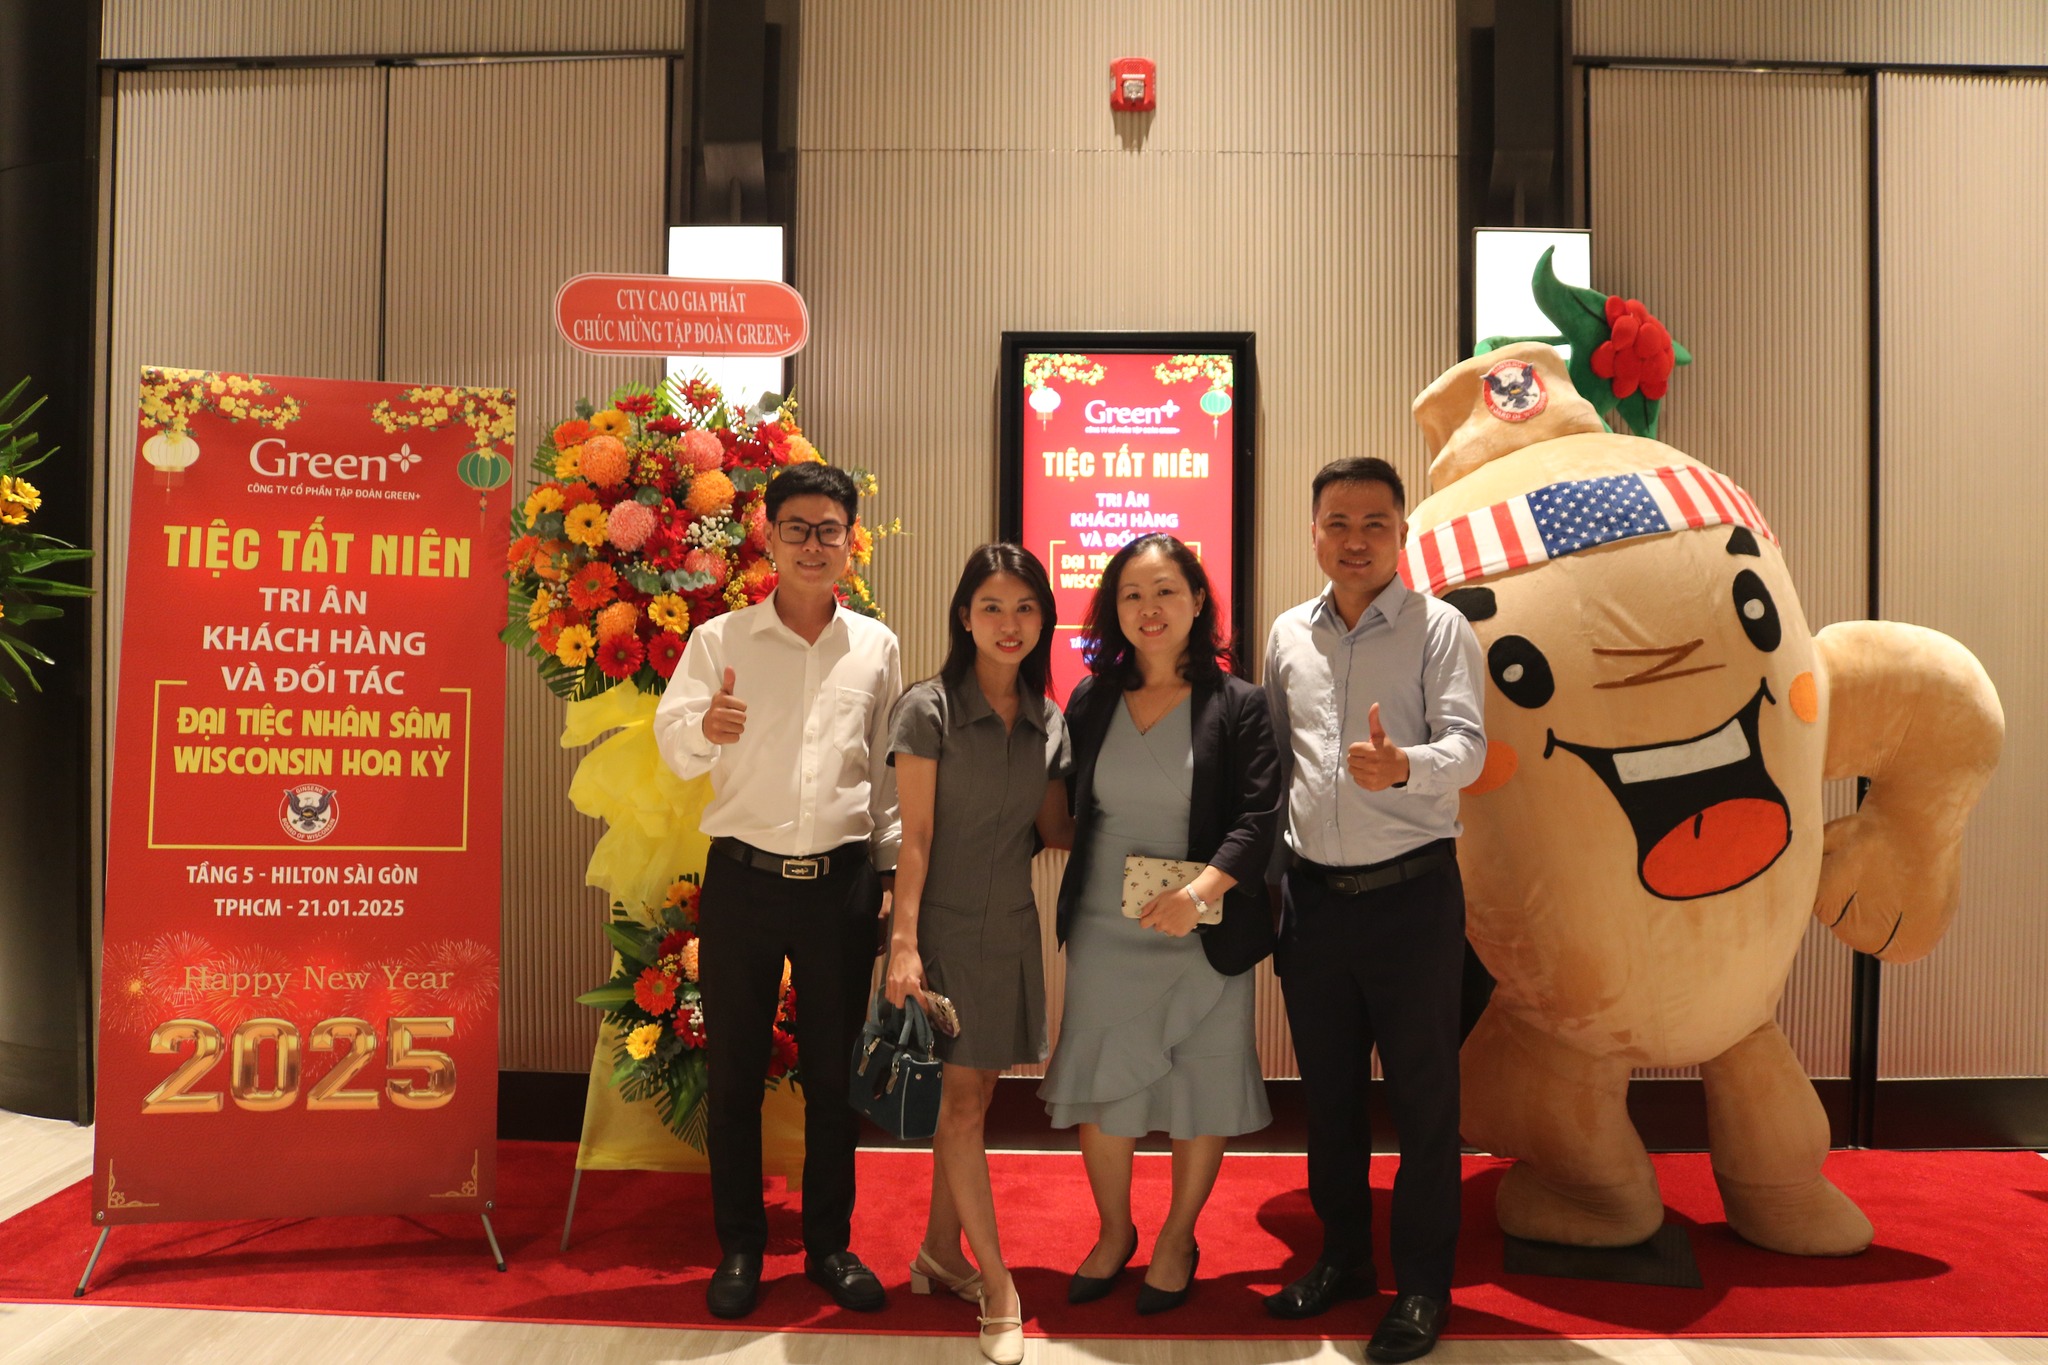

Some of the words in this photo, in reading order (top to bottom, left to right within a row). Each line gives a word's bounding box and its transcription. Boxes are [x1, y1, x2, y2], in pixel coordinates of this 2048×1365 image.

[617, 289, 645, 311] CTY
[648, 290, 679, 312] CAO
[682, 291, 708, 313] GIA
[709, 286, 746, 313] PHÁT
[573, 314, 614, 342] CHÚC
[618, 317, 662, 343] MỪNG
[664, 318, 692, 349] TẬP
[695, 317, 734, 344] ĐOÀN
[736, 323, 791, 346] GREEN+
[1043, 447, 1095, 482] TIỆC
[1102, 443, 1145, 478] TẤT
[1153, 448, 1209, 478] NIÊN
[247, 482, 273, 494] CÔNG
[276, 485, 288, 494] TY
[335, 486, 353, 499] TẬP
[355, 488, 382, 499] ĐOÀN
[384, 490, 421, 500] GREEN+
[1096, 492, 1122, 508] TRI
[1125, 491, 1149, 508] ÂN
[1070, 510, 1127, 528] KHÁCH
[1130, 510, 1179, 528] HÀNG
[163, 519, 260, 578] TIỆC
[278, 516, 354, 574] TẤT
[370, 528, 471, 578] NIÊN
[1080, 530, 1103, 547] VÀ
[1061, 554, 1085, 572] ĐẠI
[1088, 552, 1115, 572] TIỆ
[258, 586, 310, 613] TRI
[319, 585, 367, 615] ÂN
[202, 622, 319, 653] KHÁCH
[329, 625, 426, 656] HÀNG
[221, 662, 265, 692] VÀ
[274, 661, 335, 694] ĐỐI
[344, 665, 405, 695] TÁC
[177, 706, 226, 740] ĐẠI
[236, 703, 293, 742] TIỆC
[301, 705, 380, 738] NHÂN
[389, 706, 451, 739] SÂM
[173, 746, 332, 776] WISCONSIN
[342, 749, 401, 776] HOA
[410, 745, 451, 777] KỲ
[186, 861, 237, 884] TẦNG
[242, 866, 254, 884] 5
[271, 866, 338, 884] HILTON
[343, 863, 373, 884] SÀI
[378, 863, 418, 884] GÒN
[214, 898, 281, 917] TPHCM
[298, 899, 404, 917] 21.01.2025
[183, 966, 291, 998] Happy
[303, 965, 371, 991] New
[381, 965, 454, 990] Year
[142, 1016, 457, 1114] 2025
